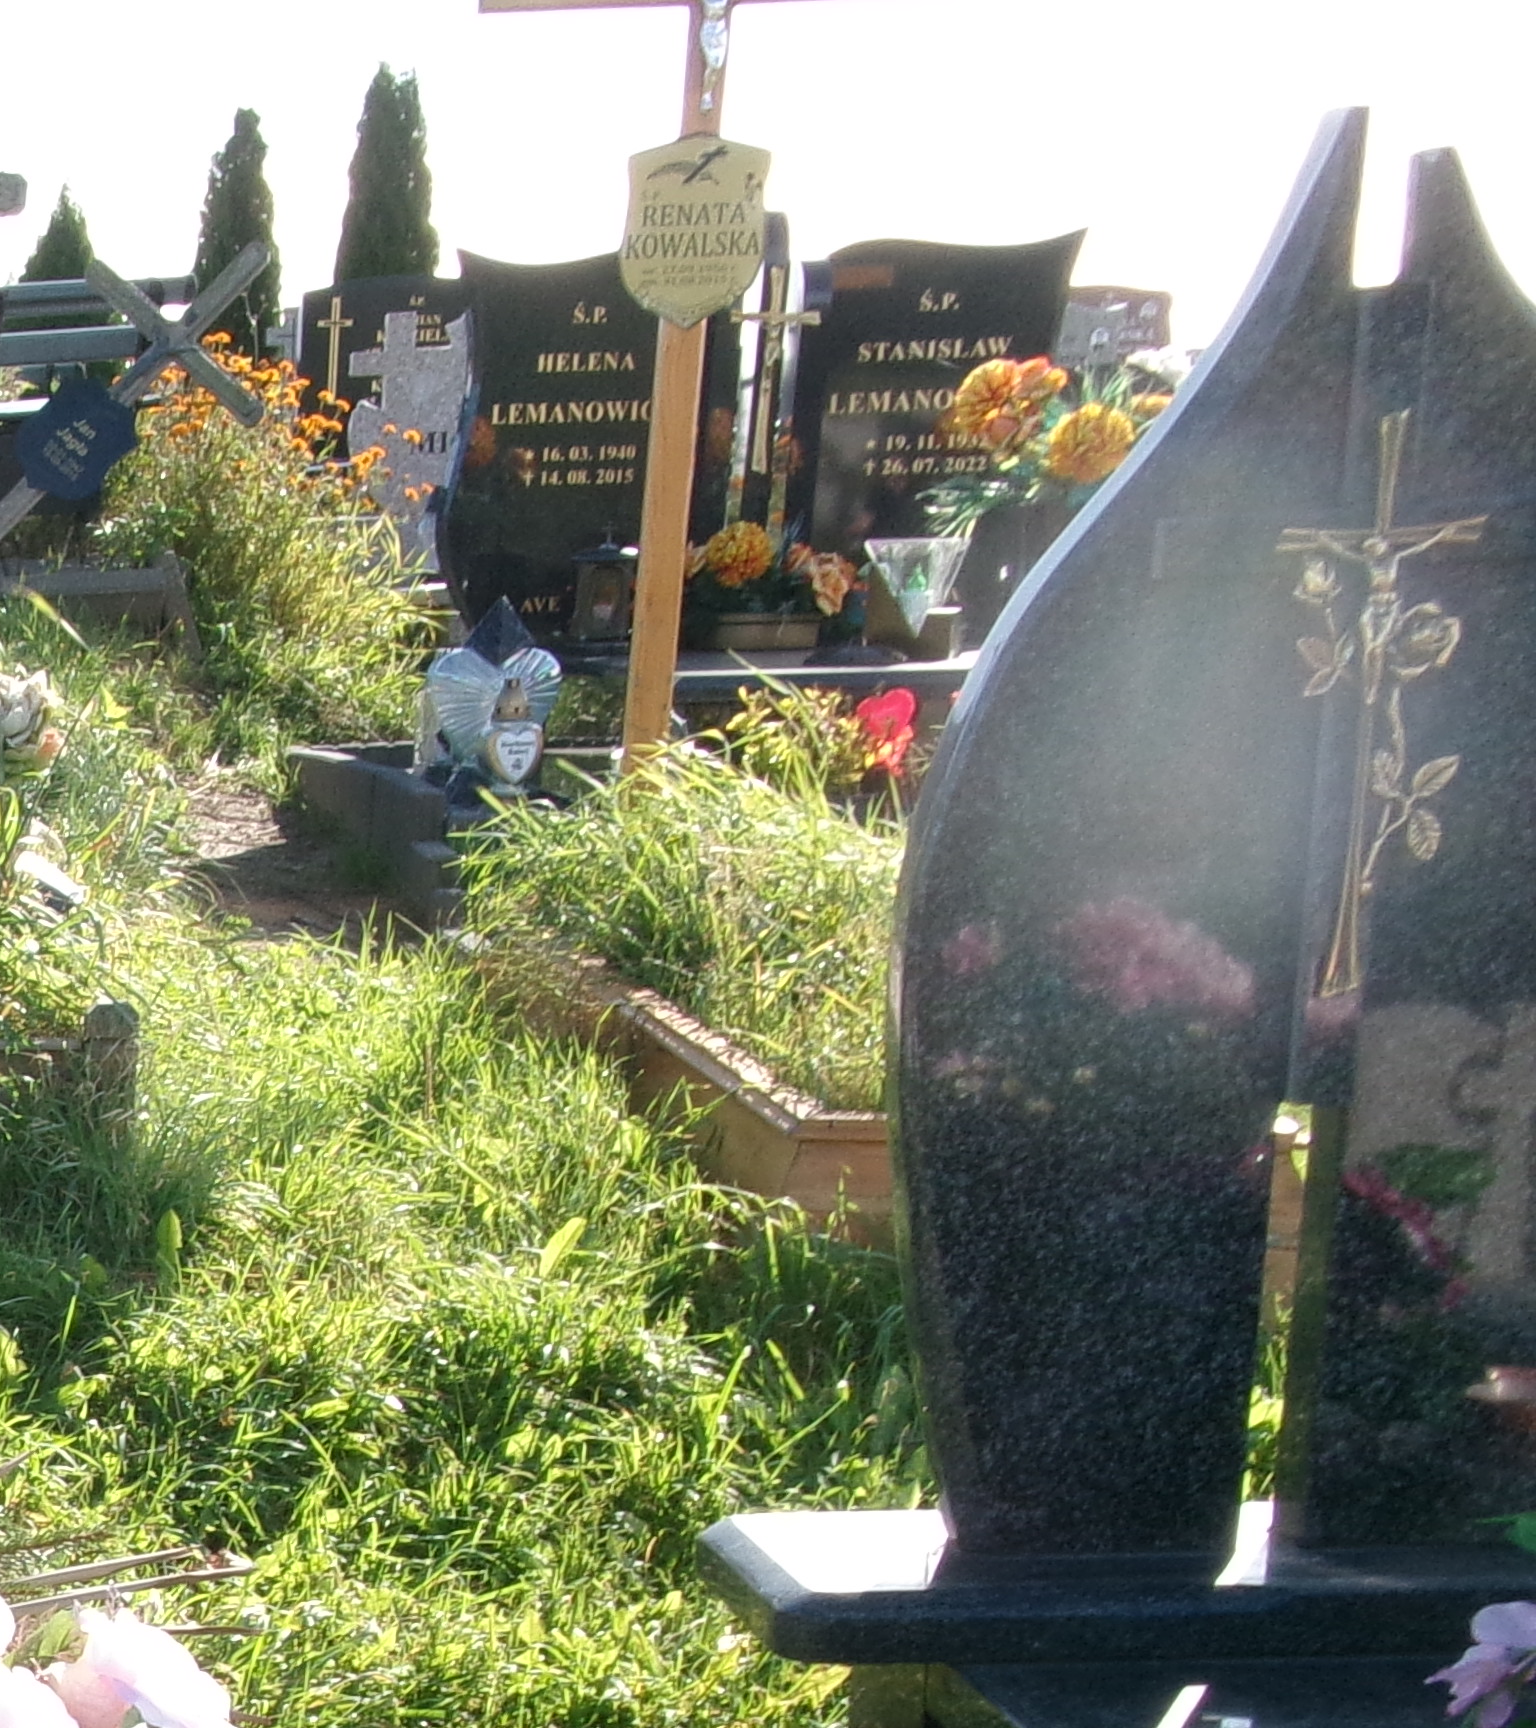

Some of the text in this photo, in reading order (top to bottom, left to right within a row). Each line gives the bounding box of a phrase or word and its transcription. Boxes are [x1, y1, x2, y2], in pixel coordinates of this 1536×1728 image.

[641, 202, 746, 228] RENATA
[625, 231, 761, 260] KOWALSKA
[572, 301, 609, 324] Ś.P.
[537, 351, 636, 373] HELENA
[490, 400, 654, 426] LEMANOWIC
